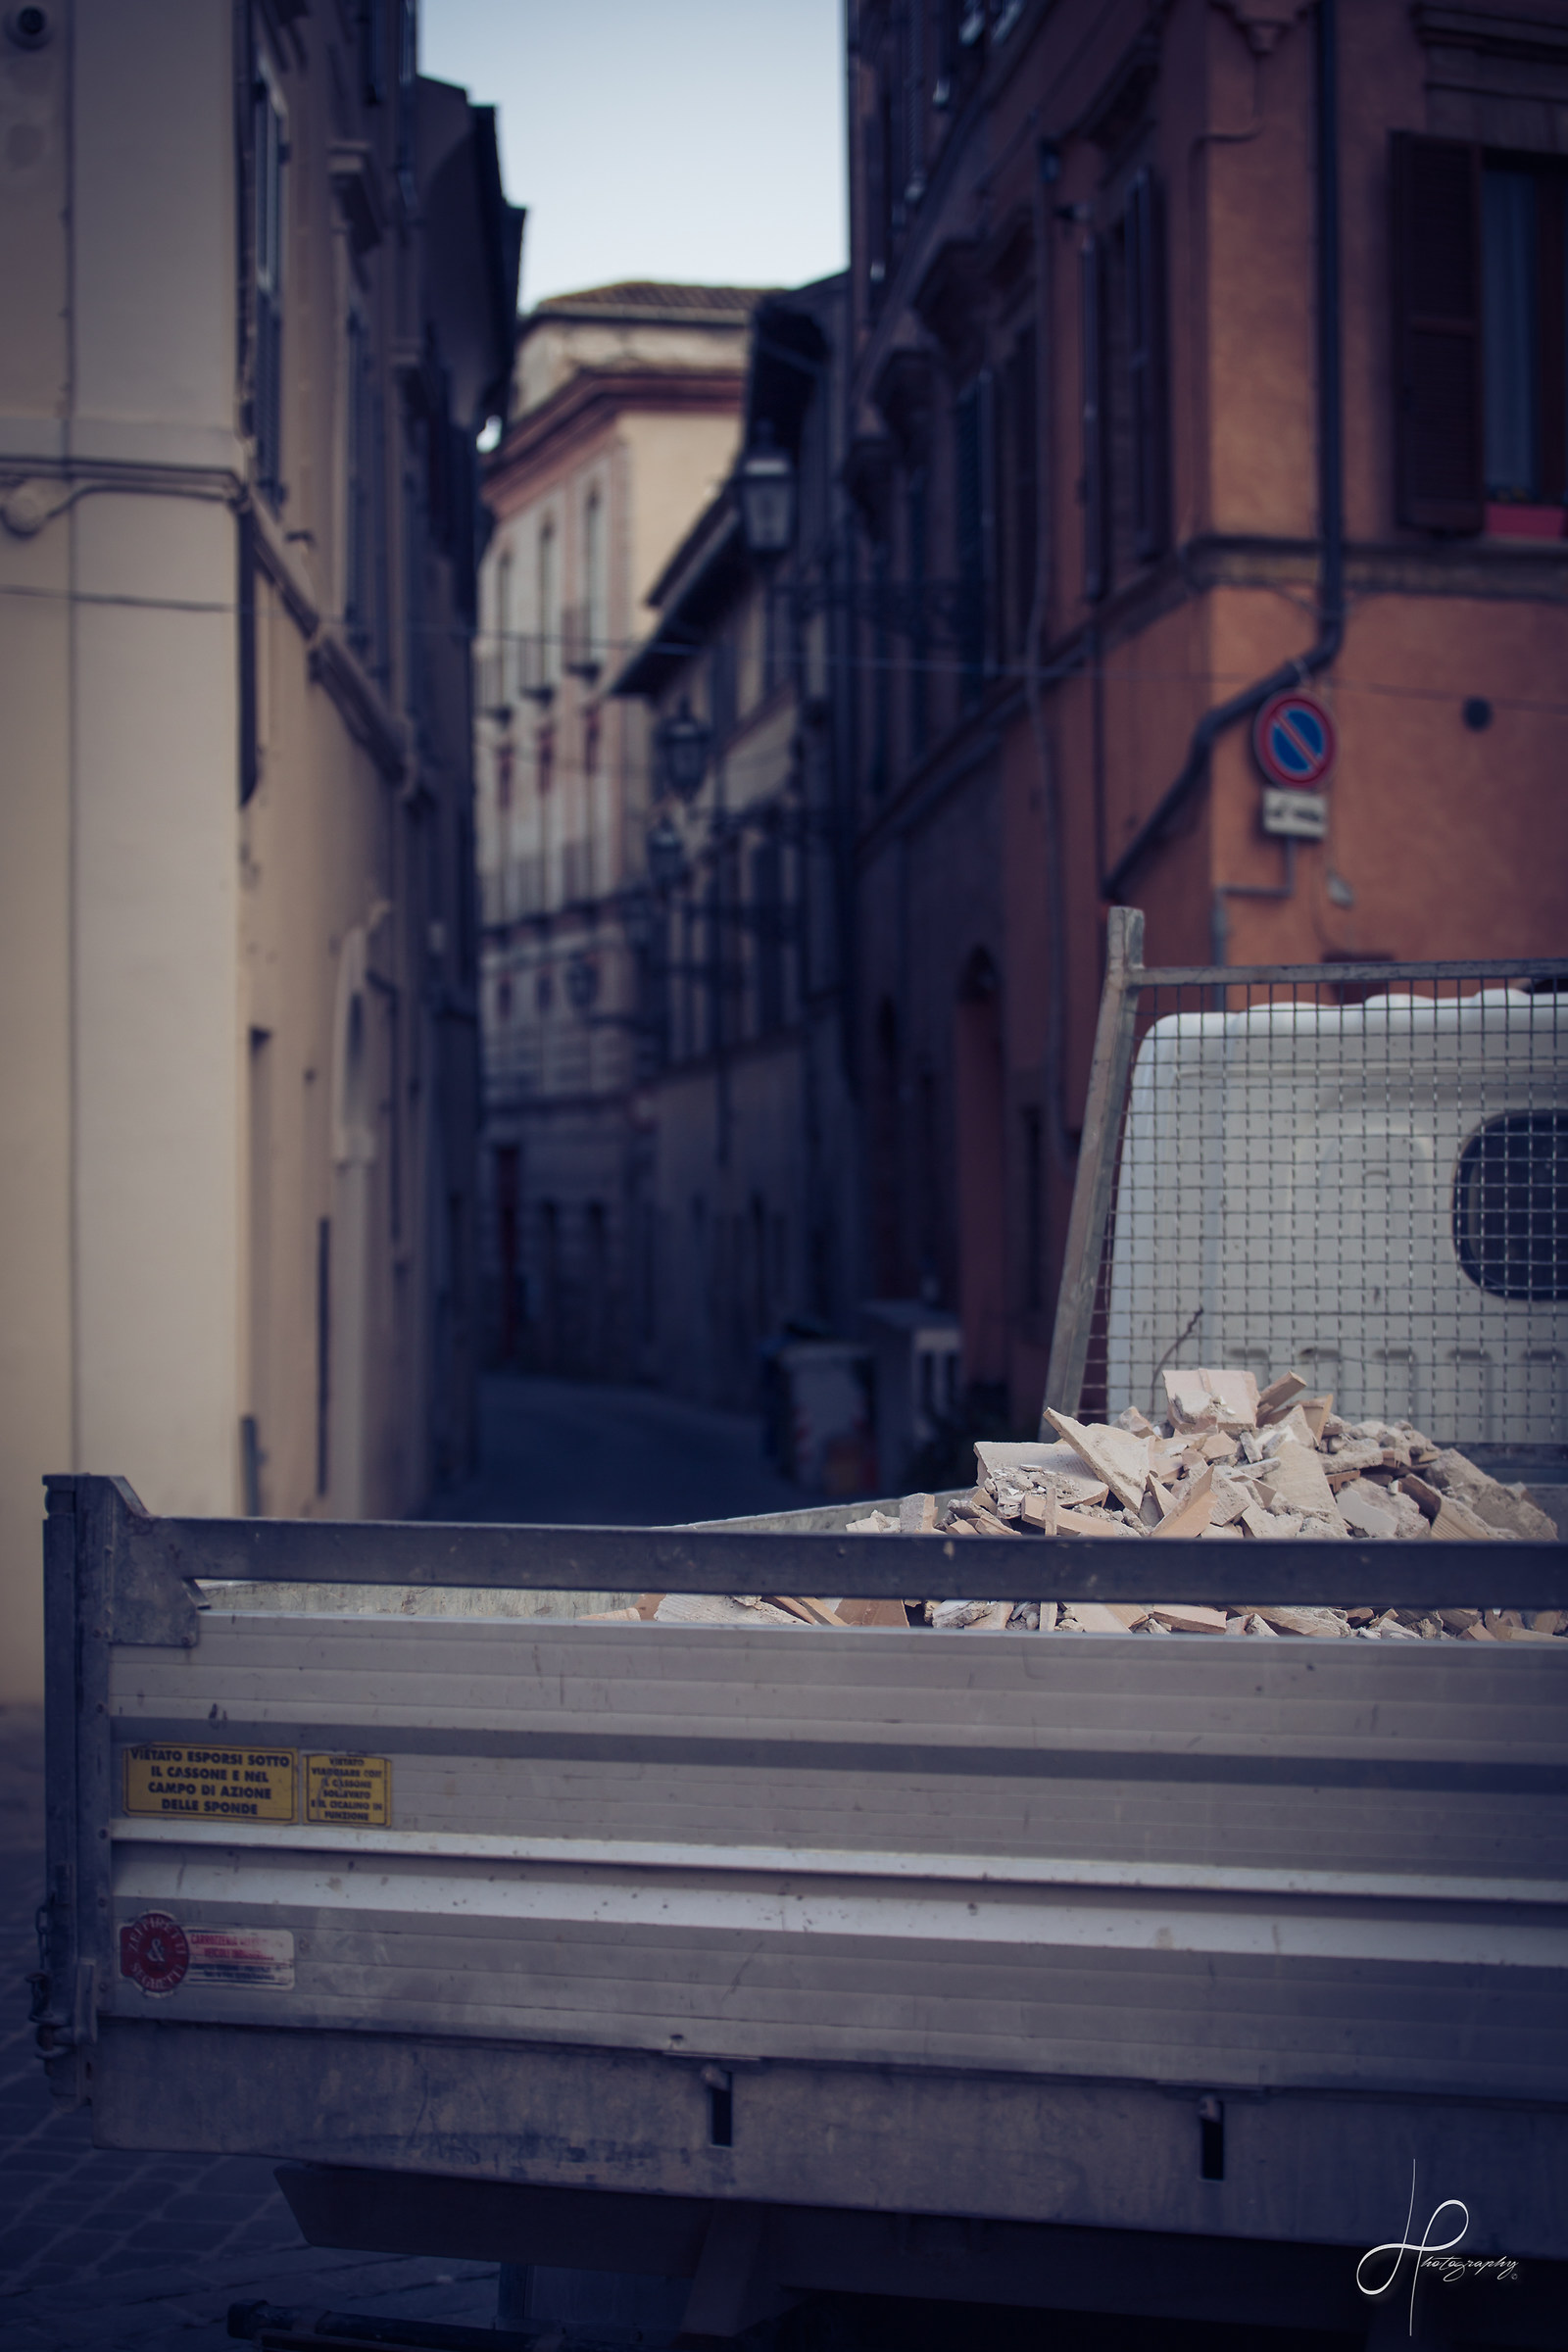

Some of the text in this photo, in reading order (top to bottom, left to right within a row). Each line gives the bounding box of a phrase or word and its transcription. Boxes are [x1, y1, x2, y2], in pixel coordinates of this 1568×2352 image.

[130, 1747, 290, 1768] VIETATO ESPORSI SOTTO
[329, 1757, 366, 1766] VIETATO
[151, 1766, 270, 1783] IL CASSONE E NEL
[148, 1782, 272, 1799] CAMPO DI AZIONE
[162, 1798, 259, 1815] DELLE SPONDE
[324, 1811, 369, 1821] FUNZIONE
[148, 1937, 165, 1963] &
